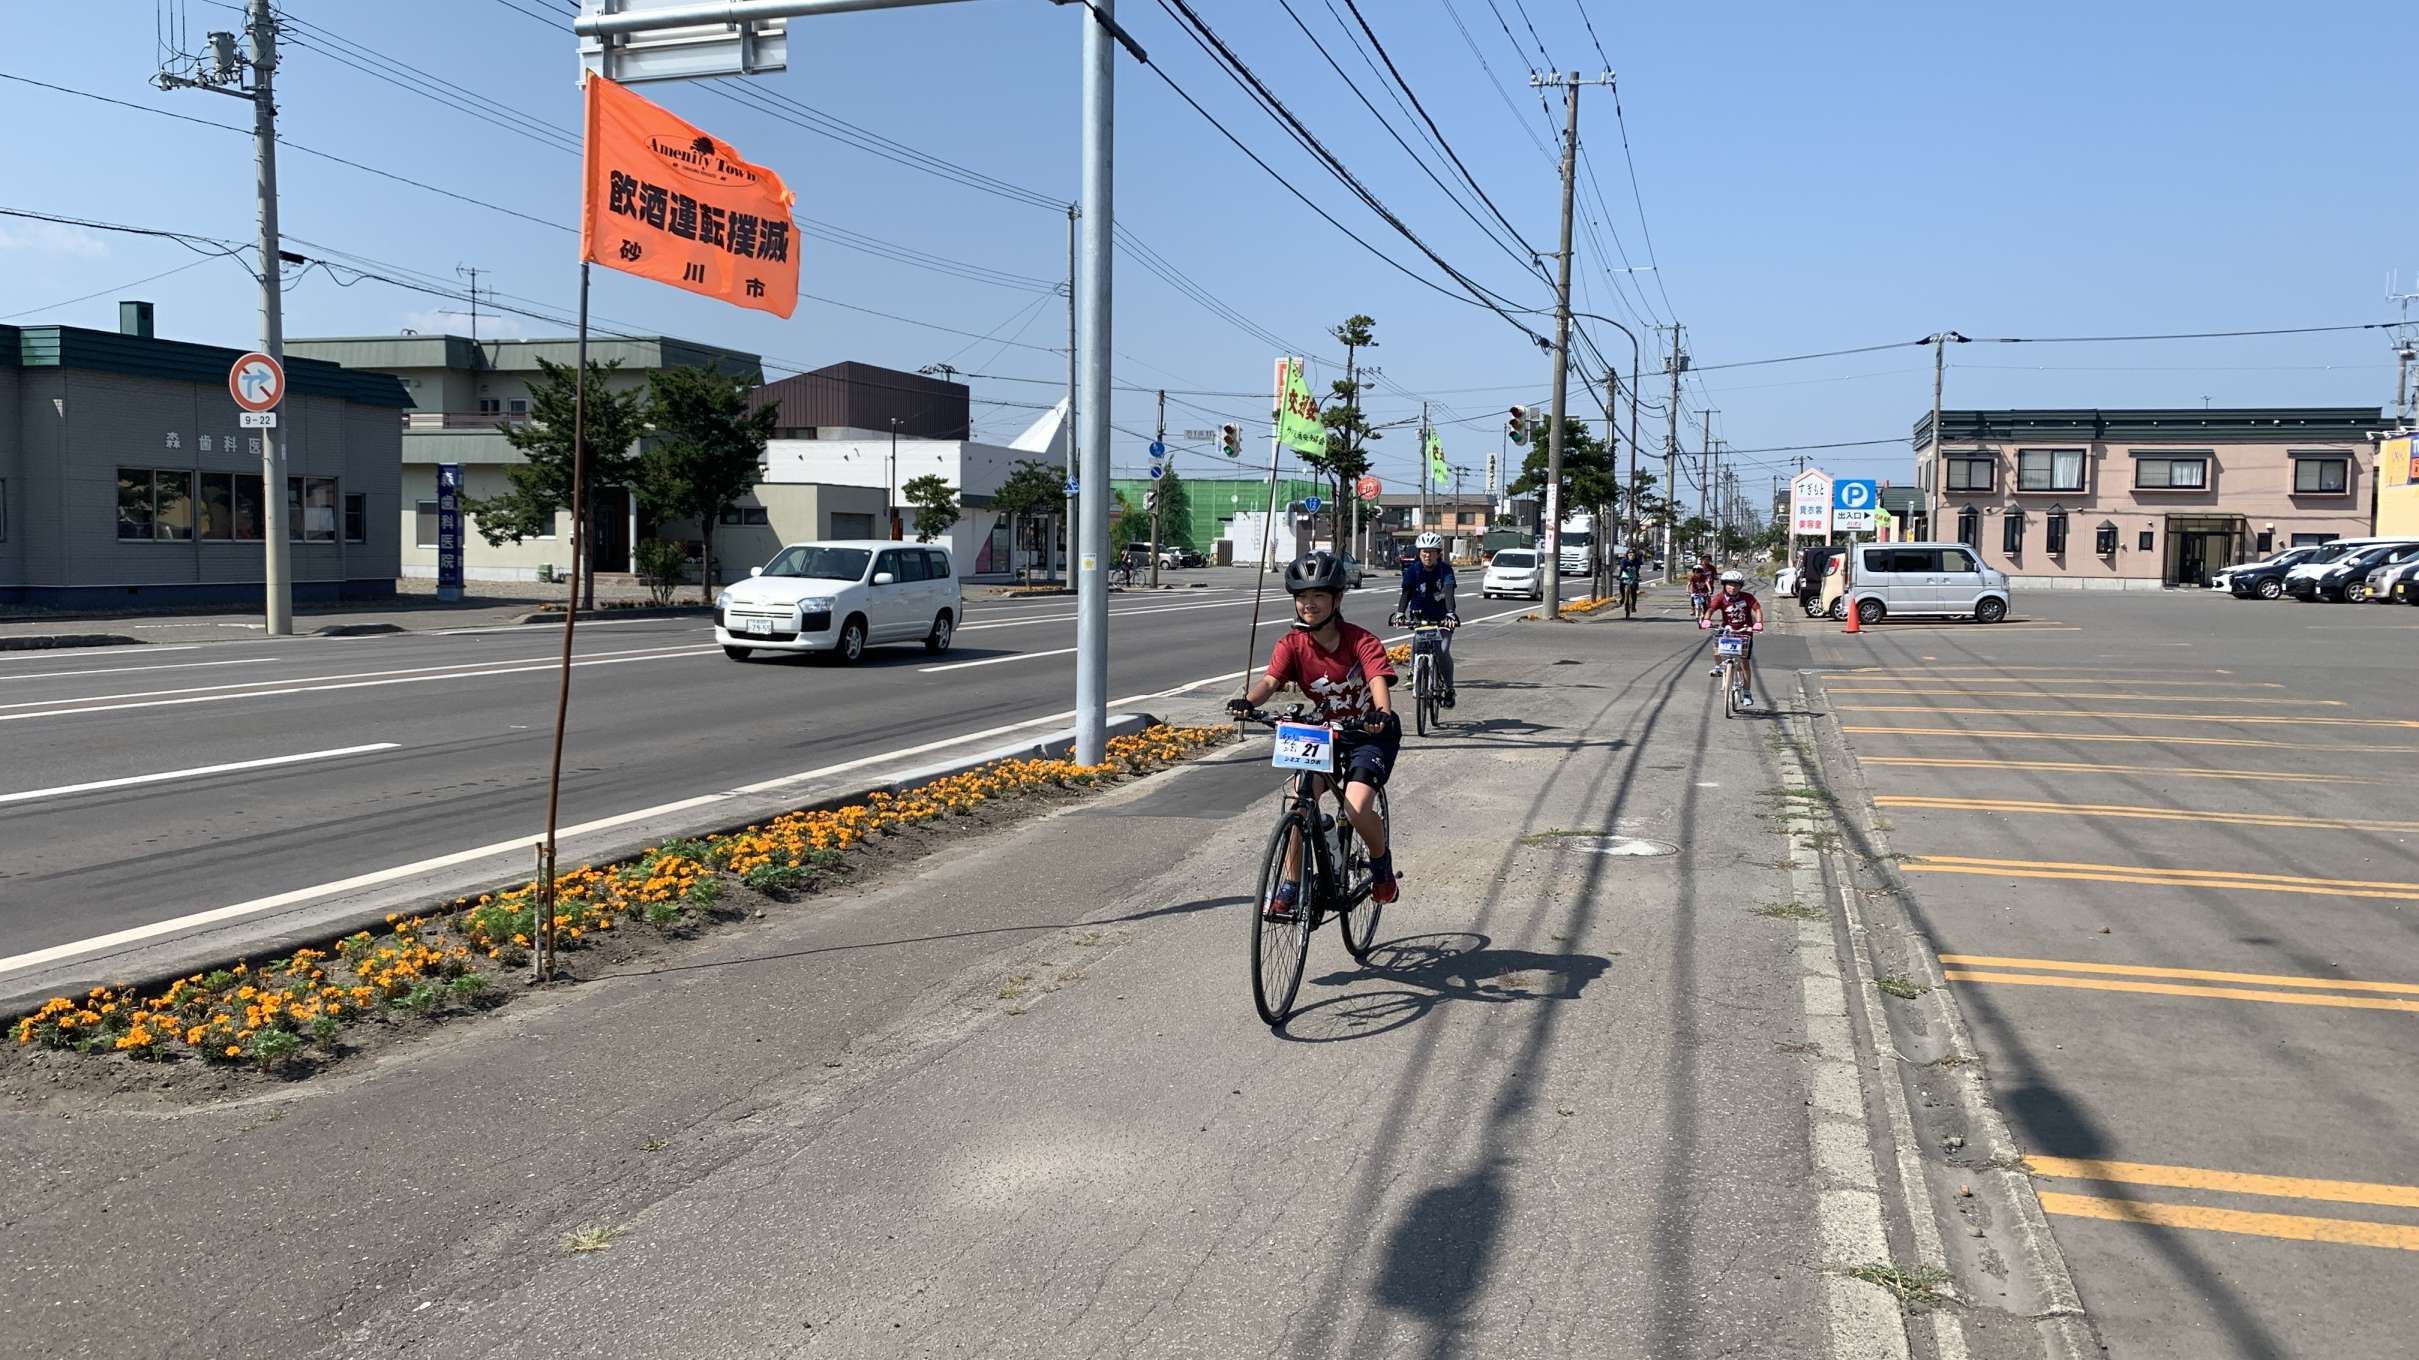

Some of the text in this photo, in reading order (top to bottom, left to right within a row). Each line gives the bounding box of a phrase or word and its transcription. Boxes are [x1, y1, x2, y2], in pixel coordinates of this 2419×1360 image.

[648, 138, 712, 170] Amenity
[716, 157, 757, 182] Town
[609, 169, 789, 264] 飲酒運転撲滅
[245, 416, 271, 425] 9-22
[1848, 487, 1864, 505] P
[440, 470, 455, 569] 森歯科医院
[1837, 511, 1862, 520] 出入口
[1302, 743, 1320, 757] 21
